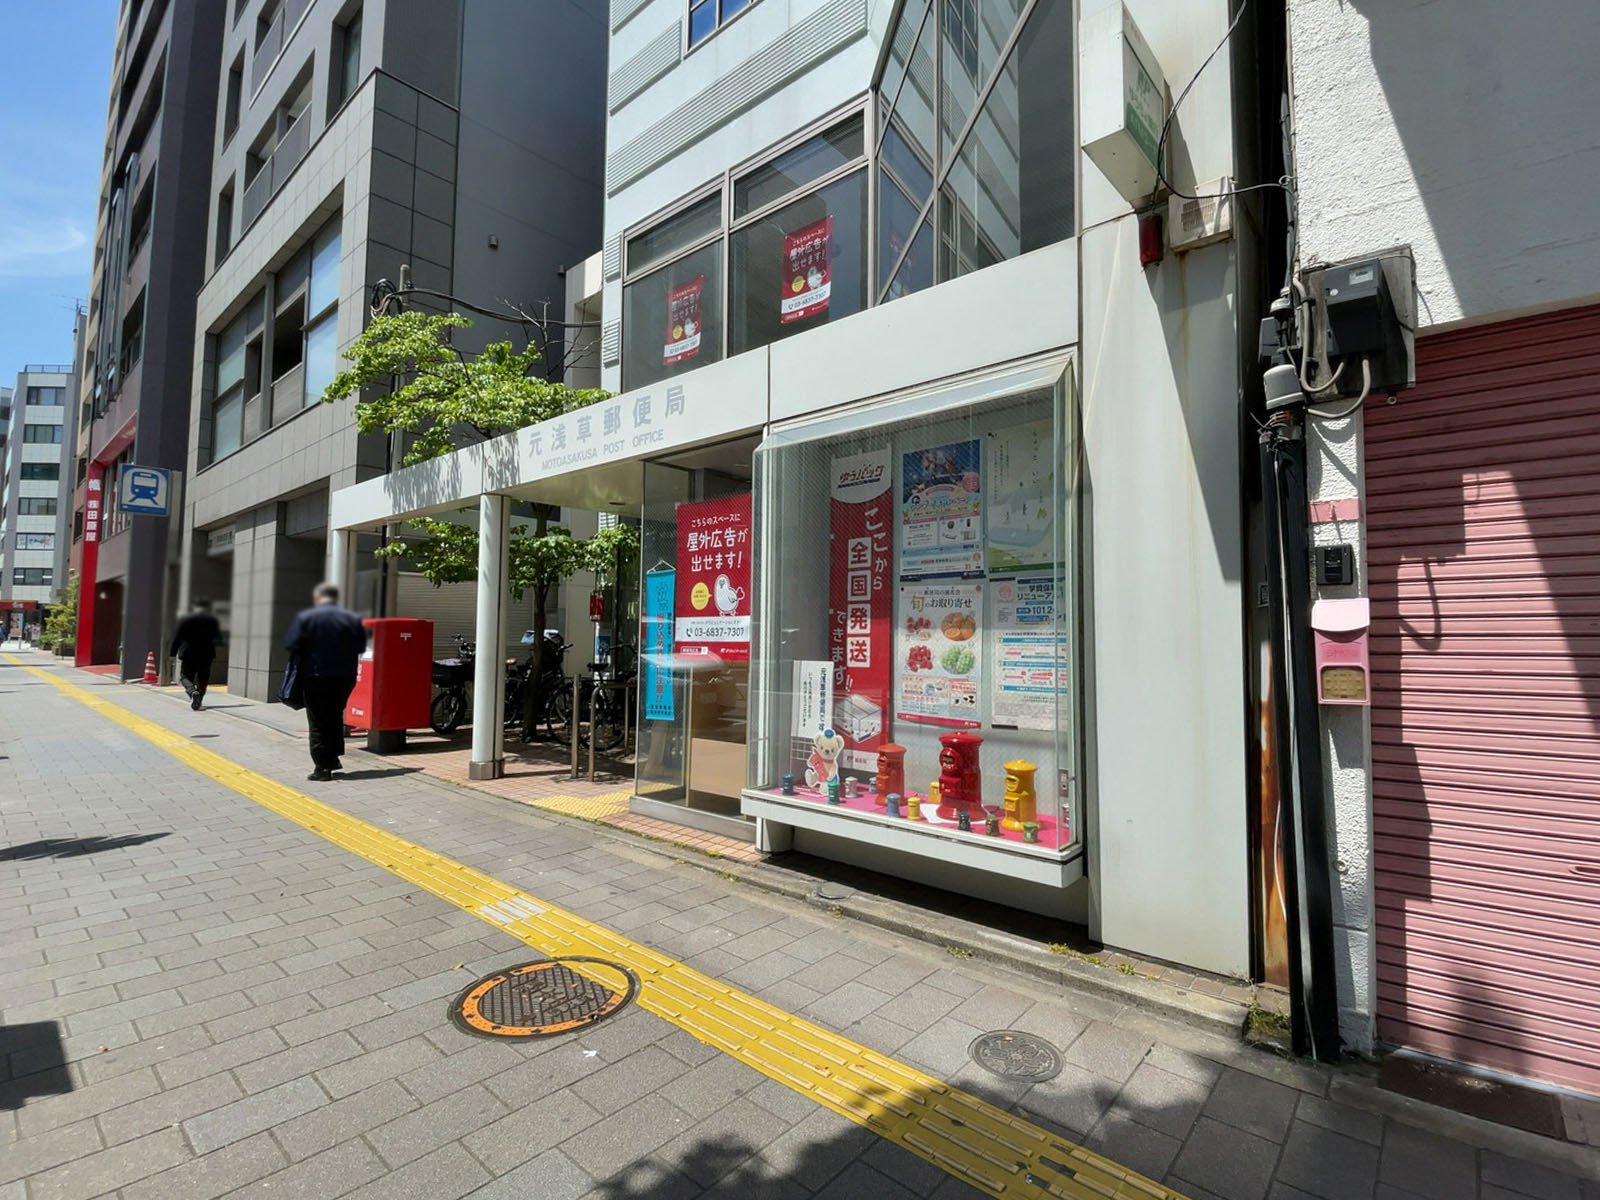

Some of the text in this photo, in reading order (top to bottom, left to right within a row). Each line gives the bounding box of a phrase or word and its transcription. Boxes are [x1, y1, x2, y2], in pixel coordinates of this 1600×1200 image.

[529, 384, 686, 458] 元浅草郵便局
[542, 428, 664, 471] MOTOASAKUSA POST OFFICE
[691, 513, 741, 528] こちらのスペースに
[687, 527, 748, 552] 屋外広告が
[864, 507, 888, 590] ここから
[691, 551, 742, 572] 出せます!
[849, 540, 869, 665] 全国発送
[694, 627, 744, 637] 03-6837-7307
